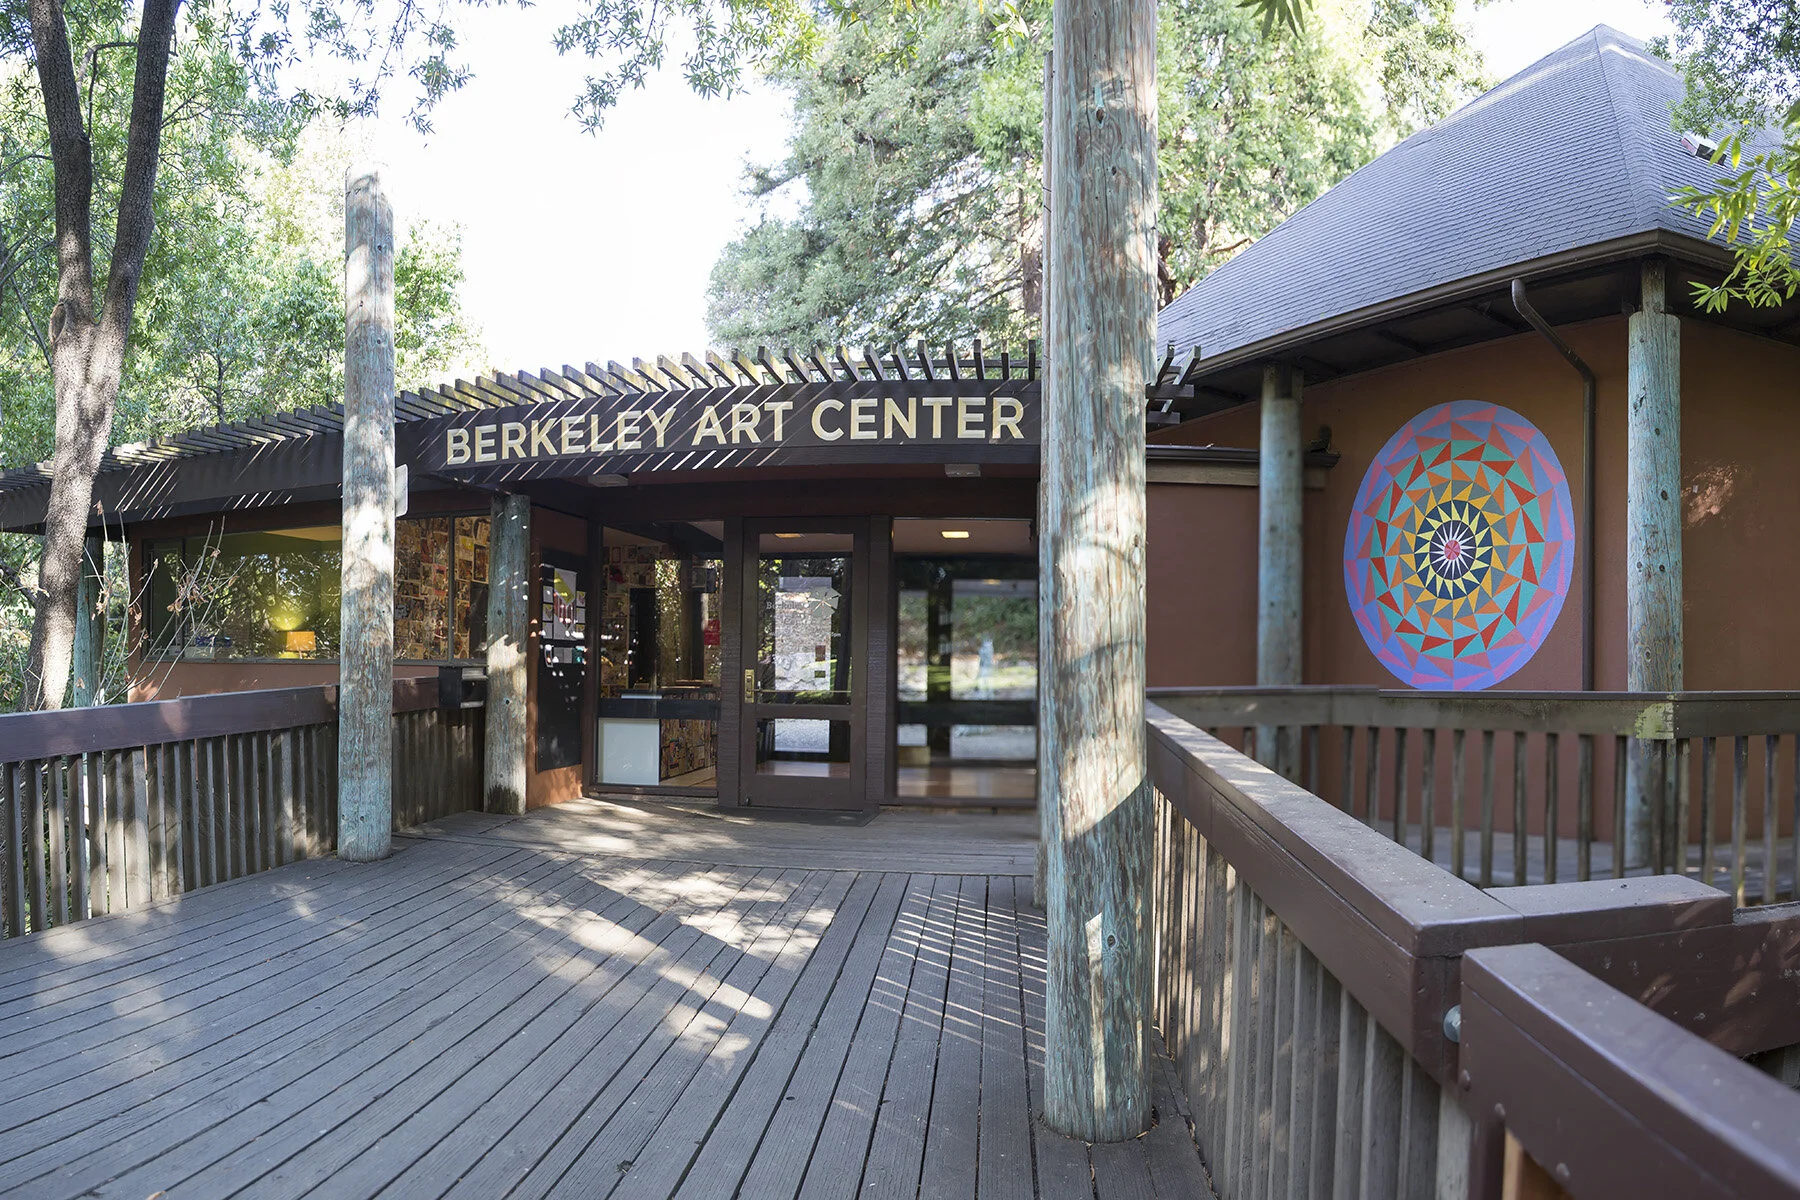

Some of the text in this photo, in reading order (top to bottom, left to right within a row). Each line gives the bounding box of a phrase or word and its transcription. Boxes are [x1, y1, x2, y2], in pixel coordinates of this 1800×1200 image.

[446, 396, 1025, 465] BERKELEY ART CENTER
